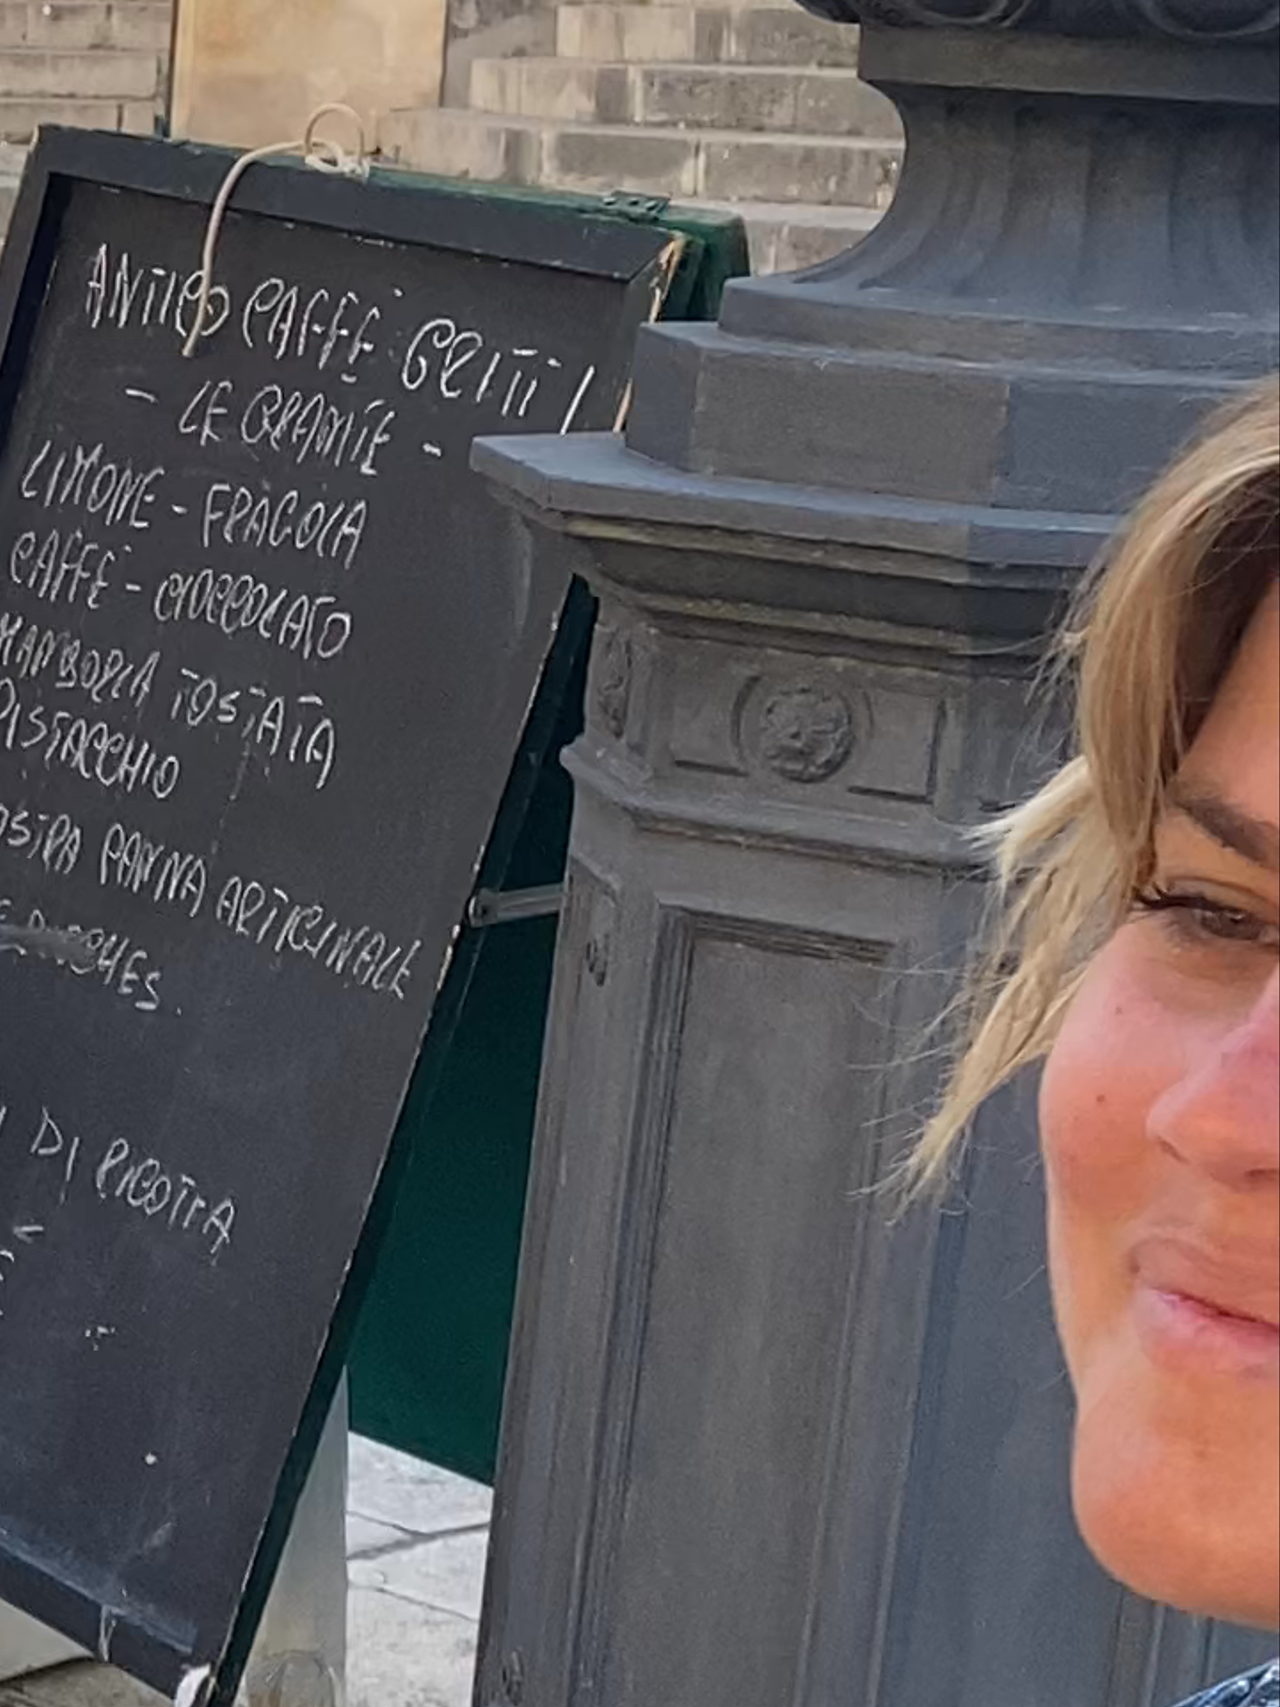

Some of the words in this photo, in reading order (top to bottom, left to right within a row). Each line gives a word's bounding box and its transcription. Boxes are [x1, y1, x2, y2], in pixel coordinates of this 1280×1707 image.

[86, 243, 230, 337] ANTICO
[179, 380, 232, 446] LE
[21, 440, 164, 528] LIMONE
[203, 483, 366, 570] FRAGOLA
[154, 568, 351, 660] CIOCCOLATO
[171, 667, 335, 790] TOSTATA
[100, 823, 206, 918] PANNA
[30, 1106, 80, 1183] DI
[96, 1137, 236, 1255] RICOTTA
